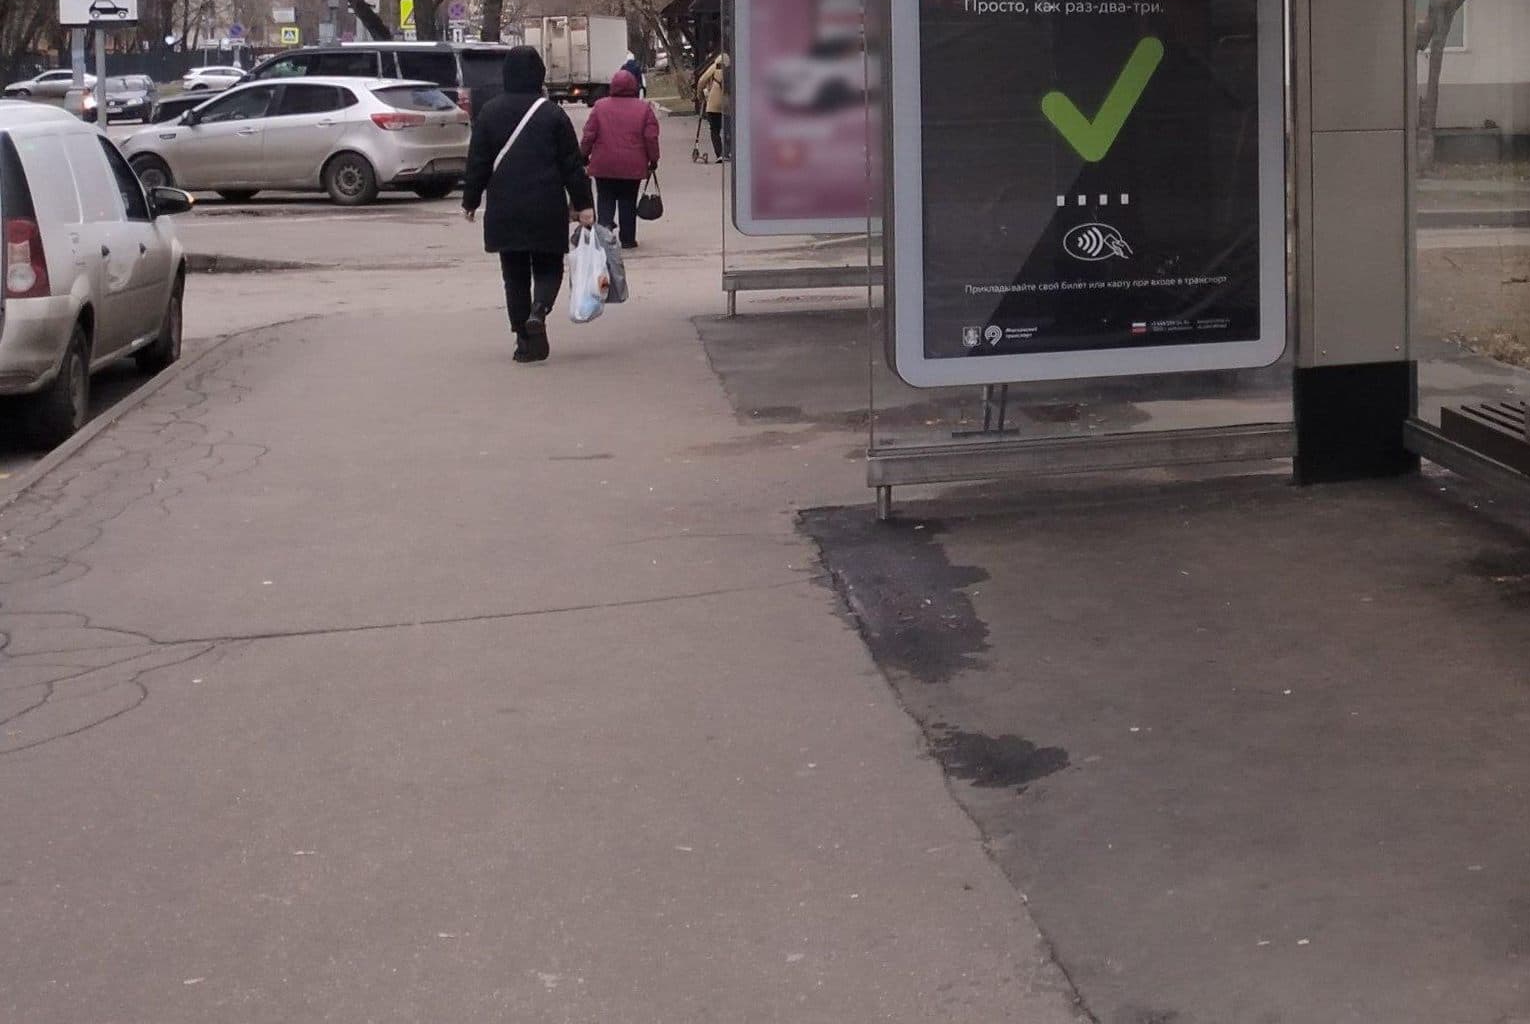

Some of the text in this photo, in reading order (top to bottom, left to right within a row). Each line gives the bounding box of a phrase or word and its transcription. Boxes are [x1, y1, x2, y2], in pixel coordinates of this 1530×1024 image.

[1034, 2, 1060, 13] как
[1065, 2, 1164, 15] раз-два-три.
[965, 282, 1036, 294] Прикладывайте
[1039, 281, 1059, 291] свой
[1062, 280, 1086, 289] билет
